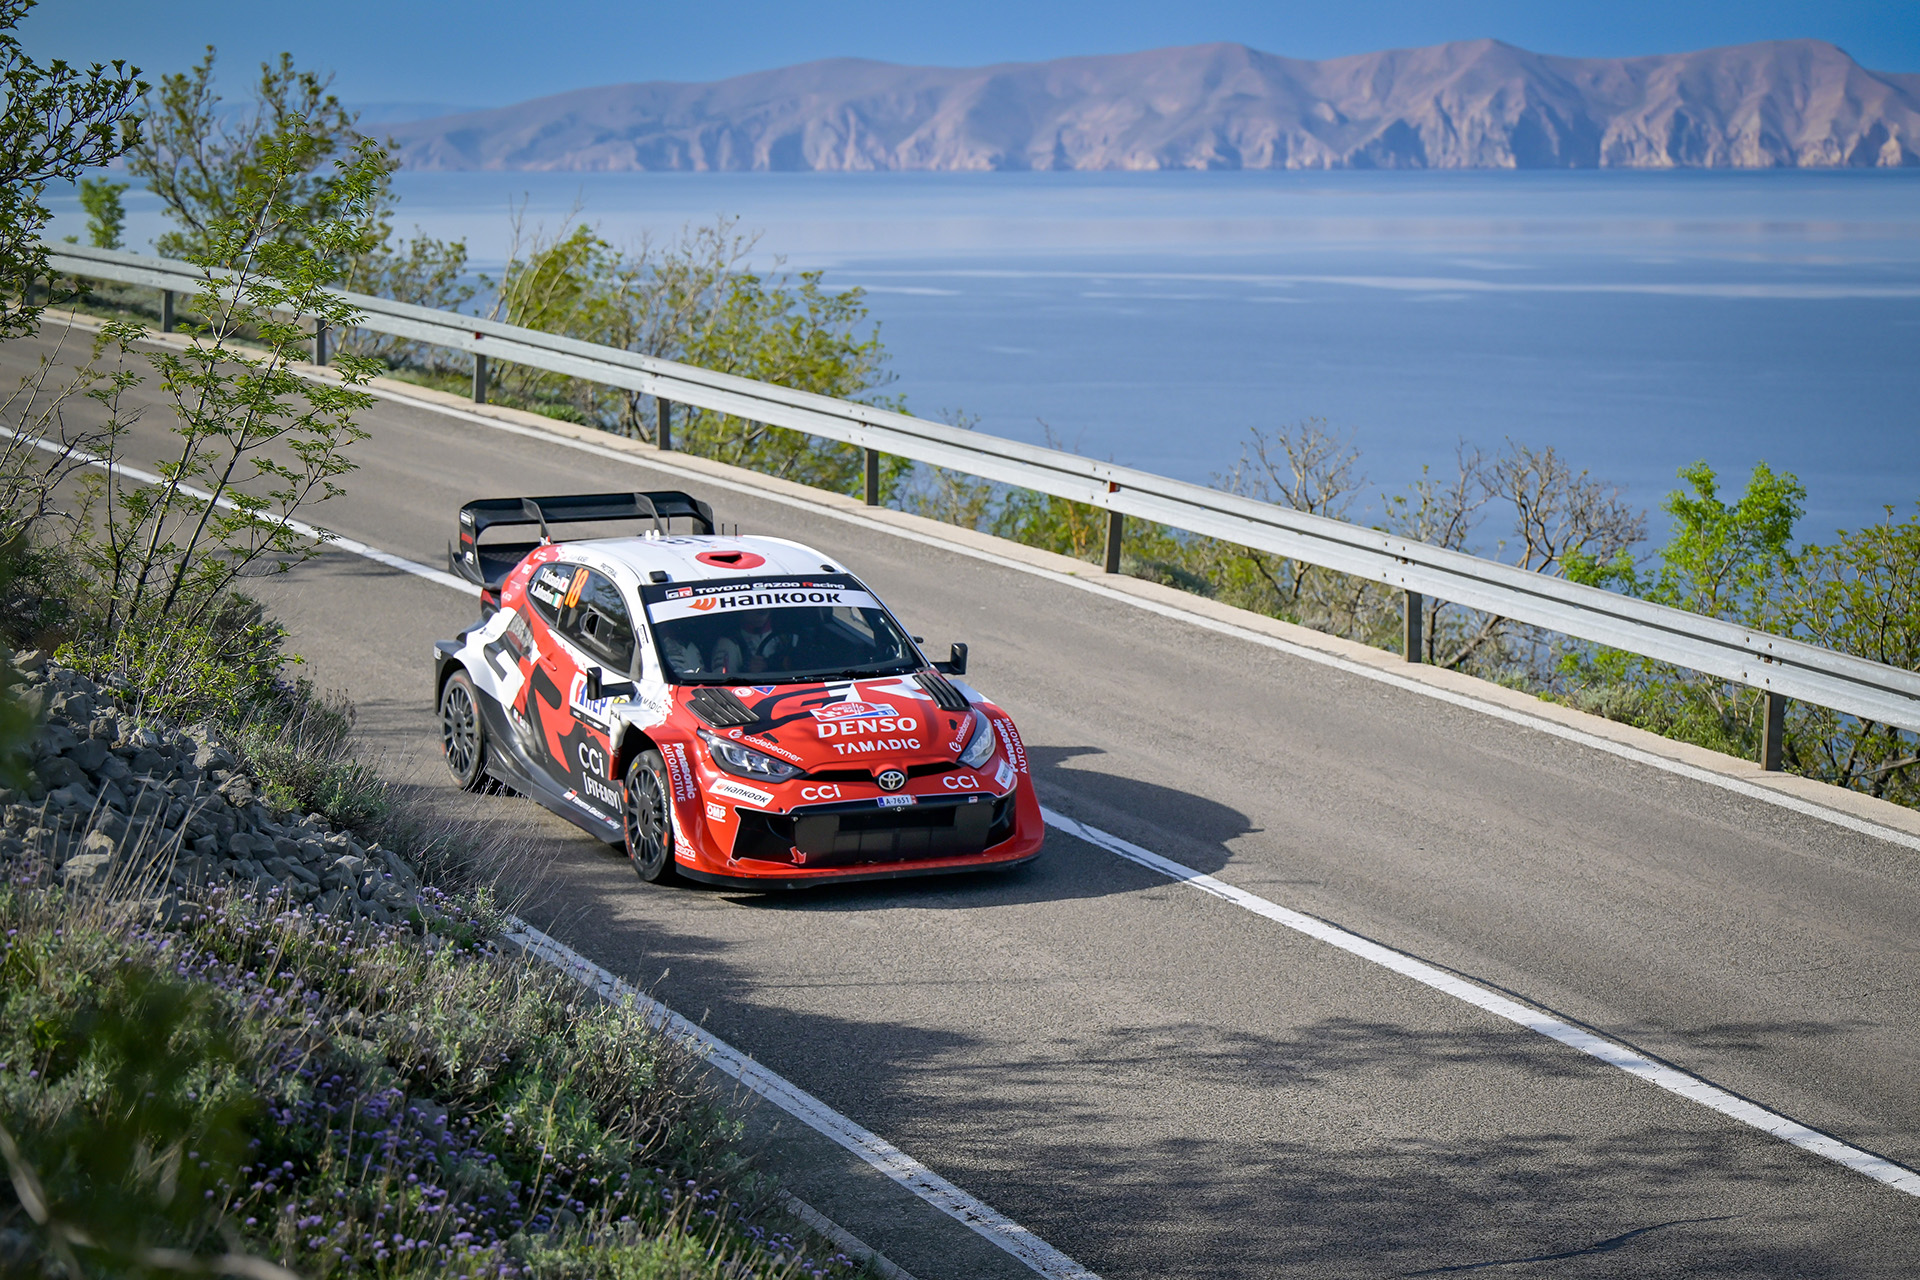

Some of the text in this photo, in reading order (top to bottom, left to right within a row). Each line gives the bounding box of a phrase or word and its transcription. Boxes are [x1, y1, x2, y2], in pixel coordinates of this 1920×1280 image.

[564, 567, 590, 609] 18
[667, 588, 693, 599] GR
[695, 584, 751, 594] TOYOTA
[816, 717, 918, 738] DENSO
[744, 734, 802, 762] codebeamer
[833, 738, 921, 755] TAMADIC
[578, 742, 605, 778] CCi
[672, 742, 697, 799] Panasonic
[661, 743, 686, 802] AUTOMOTIVE
[942, 775, 979, 789] CCi
[801, 784, 841, 800] CCi
[706, 805, 726, 819] OMP
